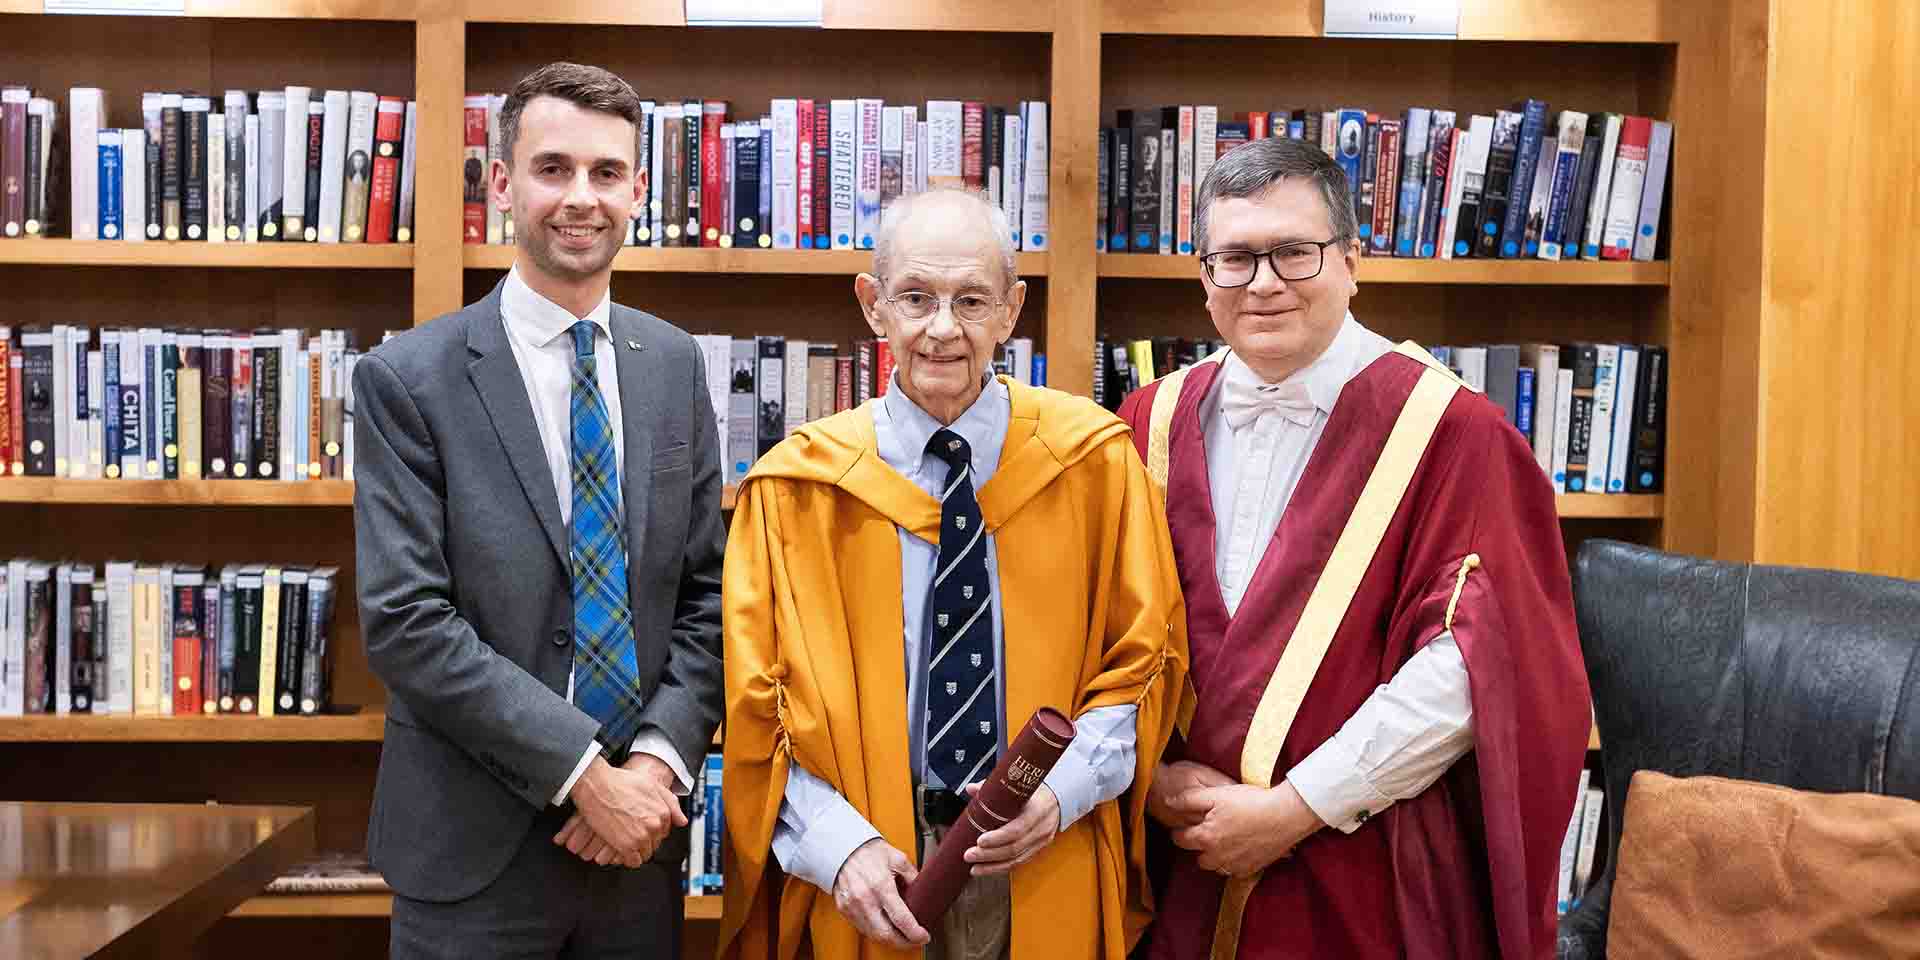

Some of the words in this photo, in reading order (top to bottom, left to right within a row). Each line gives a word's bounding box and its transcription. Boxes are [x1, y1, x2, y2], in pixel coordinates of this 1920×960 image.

[1368, 11, 1416, 24] History
[801, 168, 811, 191] THE
[834, 130, 851, 210] SHATTERED
[163, 368, 175, 402] Good
[122, 390, 139, 450] CHITA
[163, 404, 175, 440] Power
